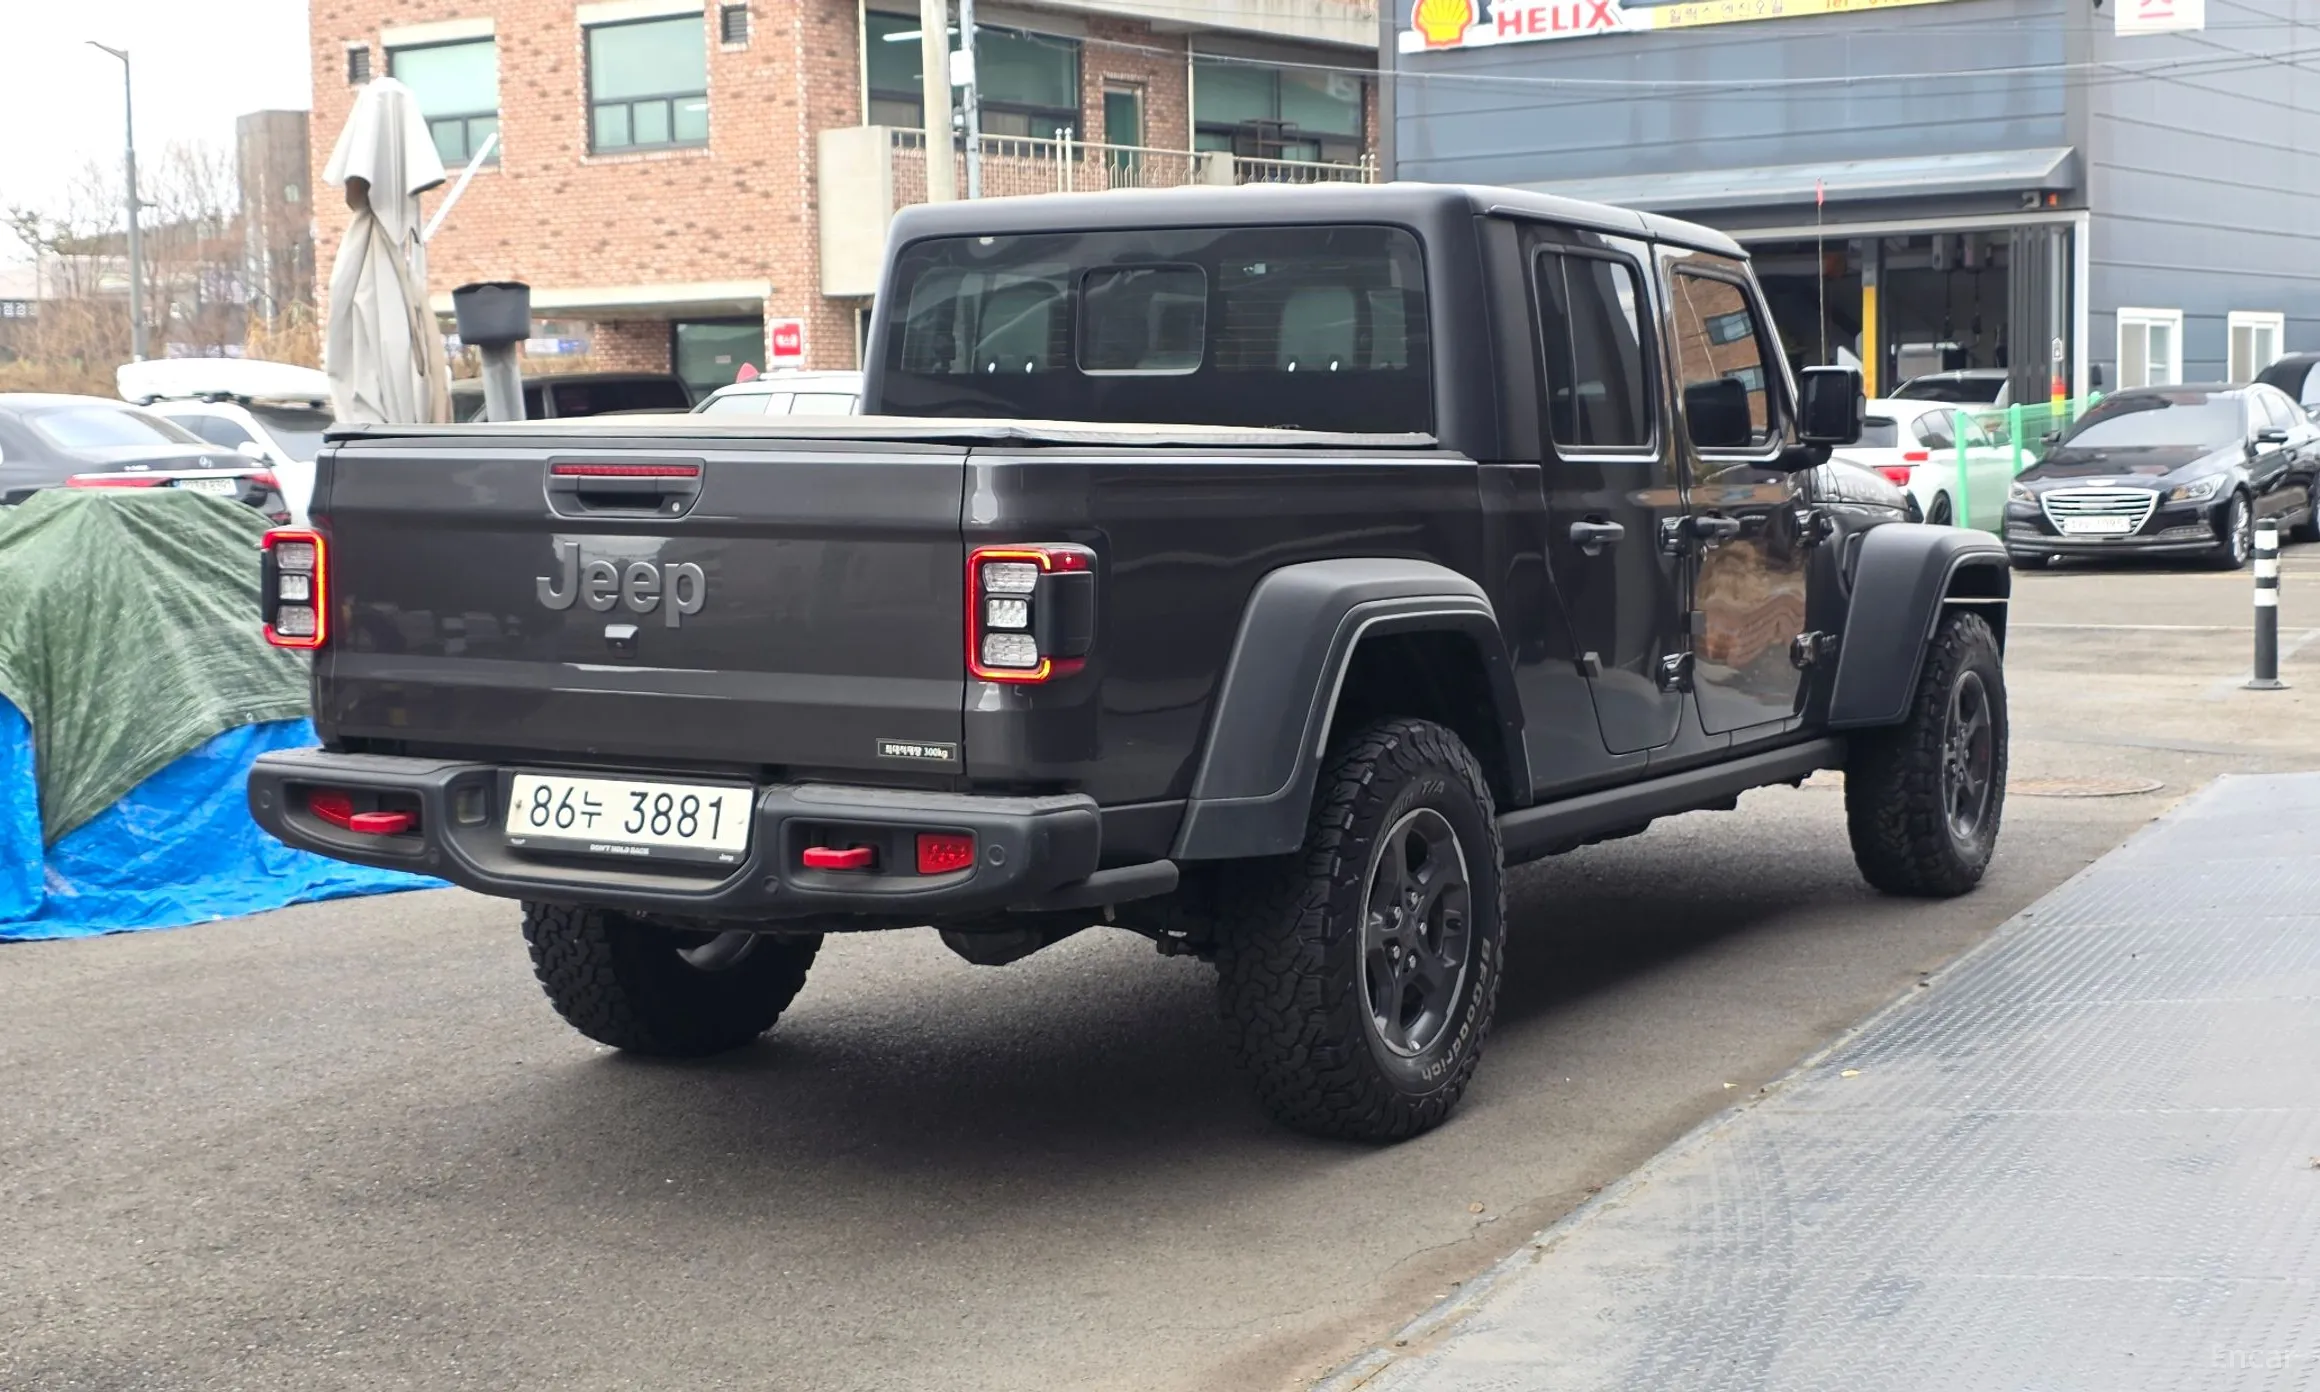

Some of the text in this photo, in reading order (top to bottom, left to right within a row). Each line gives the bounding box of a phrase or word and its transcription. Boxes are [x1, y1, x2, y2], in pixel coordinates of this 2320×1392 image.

[1497, 0, 1616, 36] HELIX
[536, 541, 706, 629] Jeep
[924, 746, 949, 760] 300kg
[530, 785, 723, 840] 86누 3881
